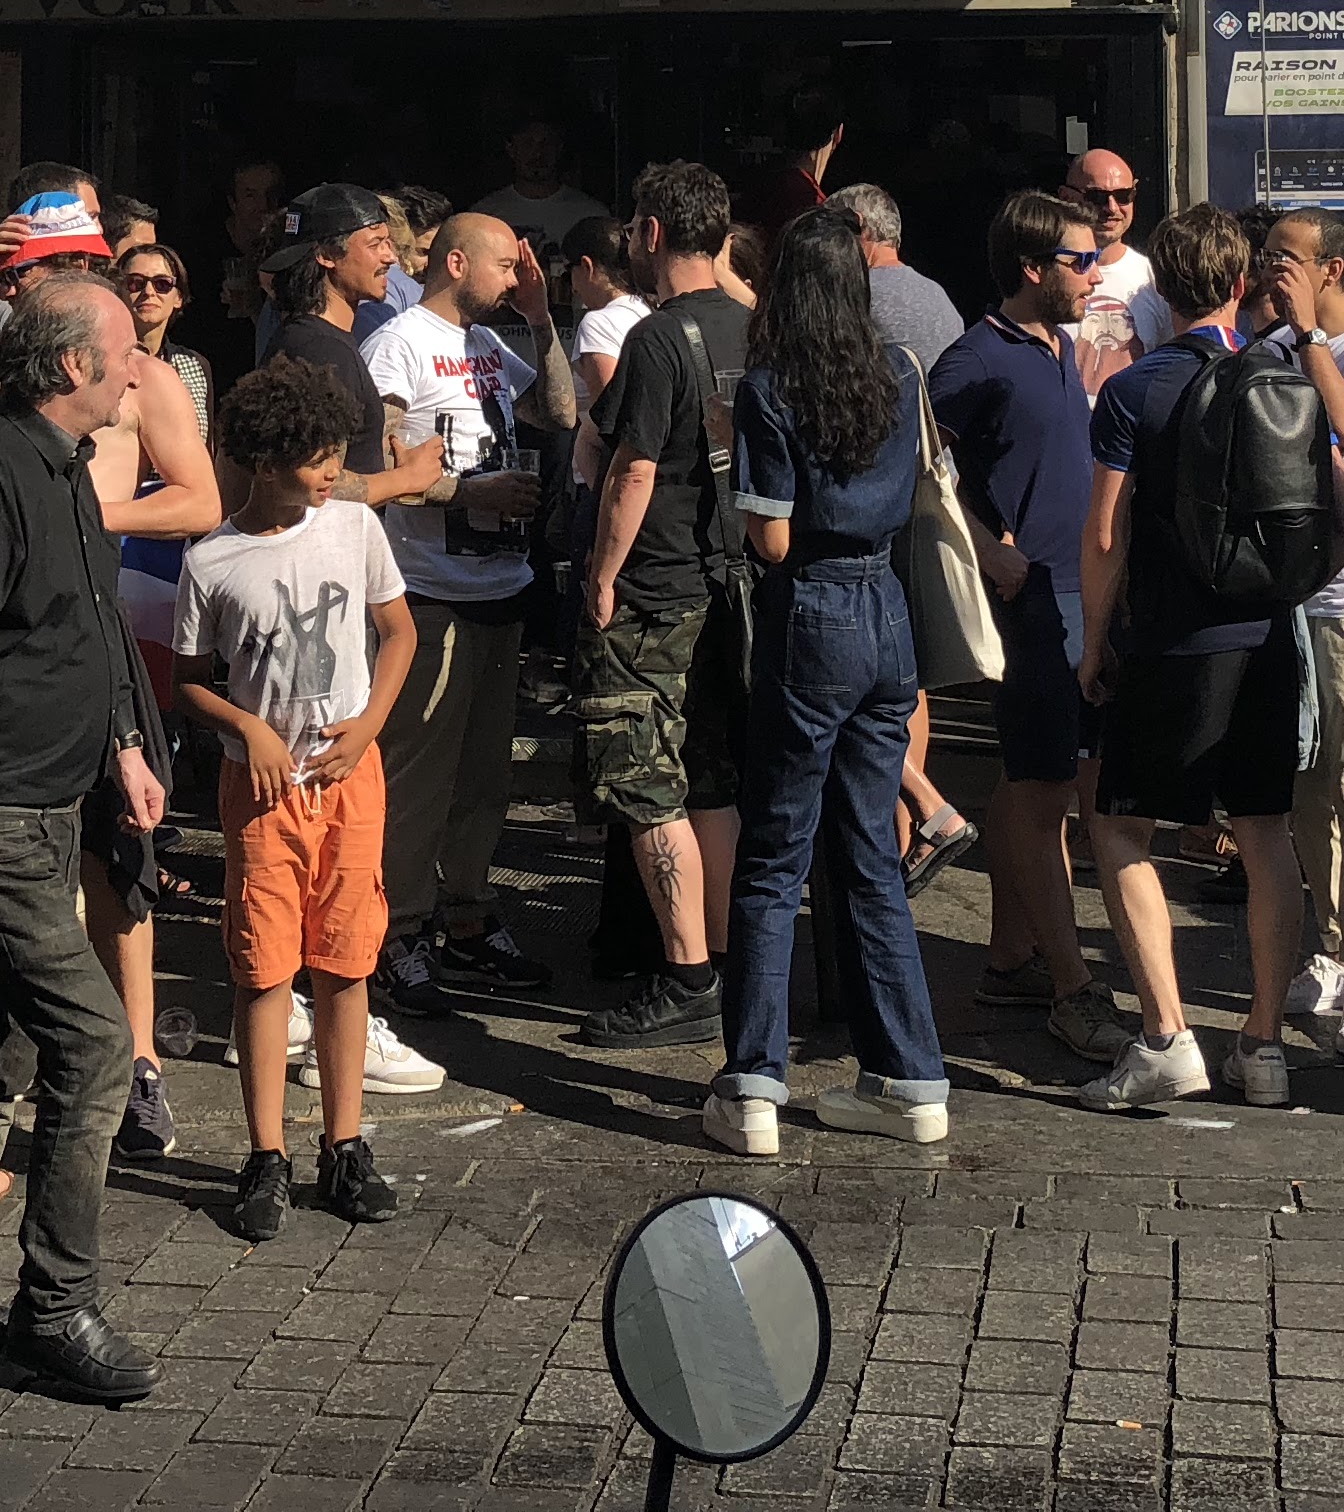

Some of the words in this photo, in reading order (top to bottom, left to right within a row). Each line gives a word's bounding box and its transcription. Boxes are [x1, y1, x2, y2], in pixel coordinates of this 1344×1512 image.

[1309, 32, 1338, 40] POINT
[1236, 59, 1337, 72] RAISON
[1234, 74, 1259, 83] pour
[1308, 72, 1335, 83] point
